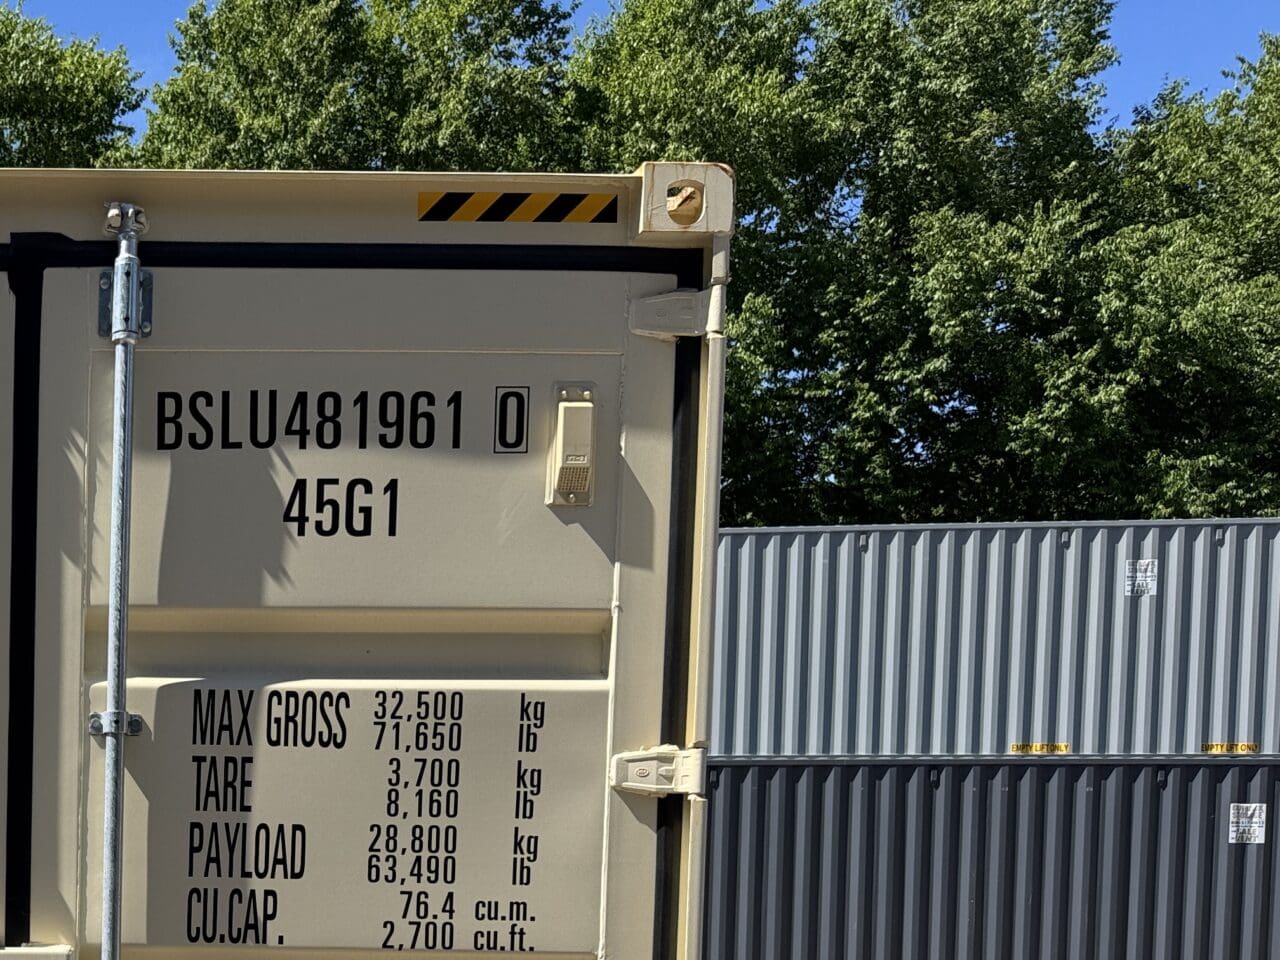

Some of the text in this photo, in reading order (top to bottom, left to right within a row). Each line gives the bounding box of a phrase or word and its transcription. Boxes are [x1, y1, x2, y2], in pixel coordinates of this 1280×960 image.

[156, 389, 463, 450] BSLU481961
[282, 478, 400, 537] 45G1
[191, 688, 546, 749] MAX GROSS 32,500 kg
[373, 721, 538, 753] 71,650 lb
[192, 755, 542, 812] TARE 3,700 kg
[386, 788, 535, 820] 8,160 lb
[188, 822, 539, 880] PAYLOAD 28,800 kg
[367, 854, 532, 886] 63,490 lb
[186, 887, 537, 945] CU.CAP. 76.4 cu.m.
[382, 921, 536, 952] 2,700 cu.ft.
